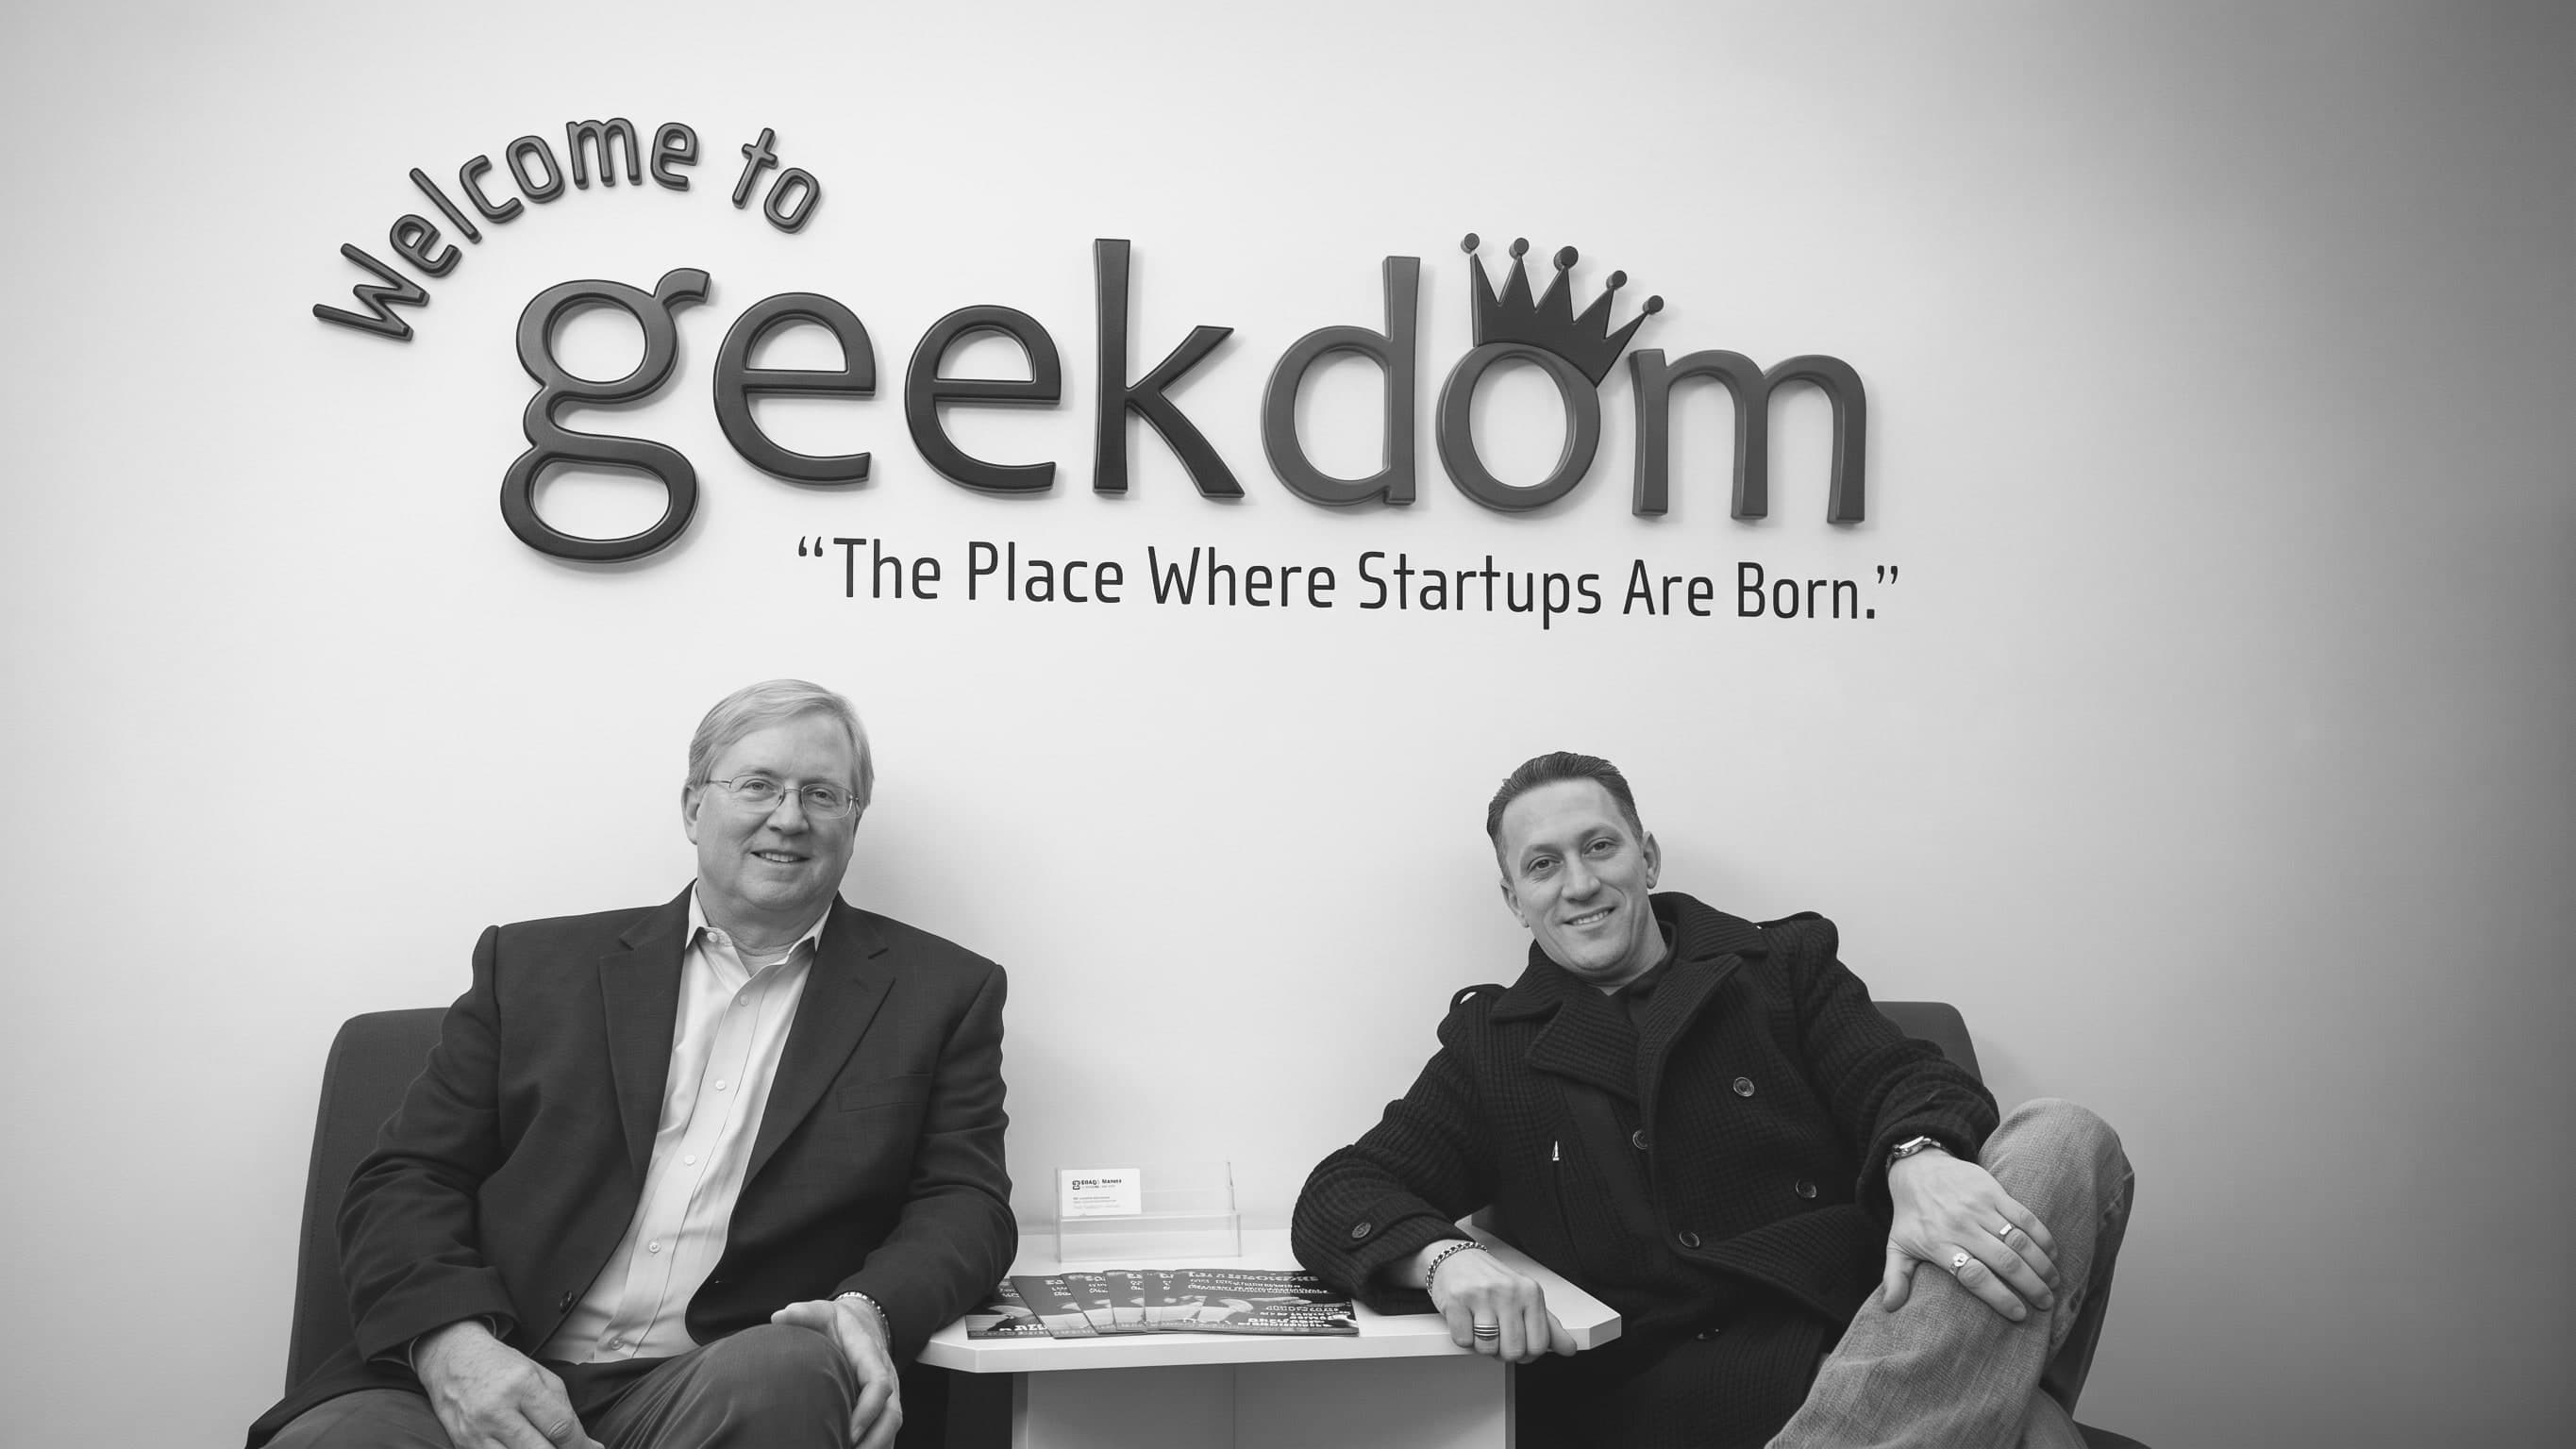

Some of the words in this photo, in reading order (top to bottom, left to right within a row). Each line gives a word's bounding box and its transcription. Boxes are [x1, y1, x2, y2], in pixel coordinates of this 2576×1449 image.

[312, 116, 700, 342] Welcome
[731, 127, 821, 235] to
[499, 238, 1868, 565] geekdom
[798, 536, 941, 602] “The
[968, 541, 1124, 604] Place
[1147, 545, 1335, 608] Where
[1359, 551, 1601, 630] Startups
[1622, 558, 1714, 617] Are
[1737, 561, 1899, 621] Born.”
